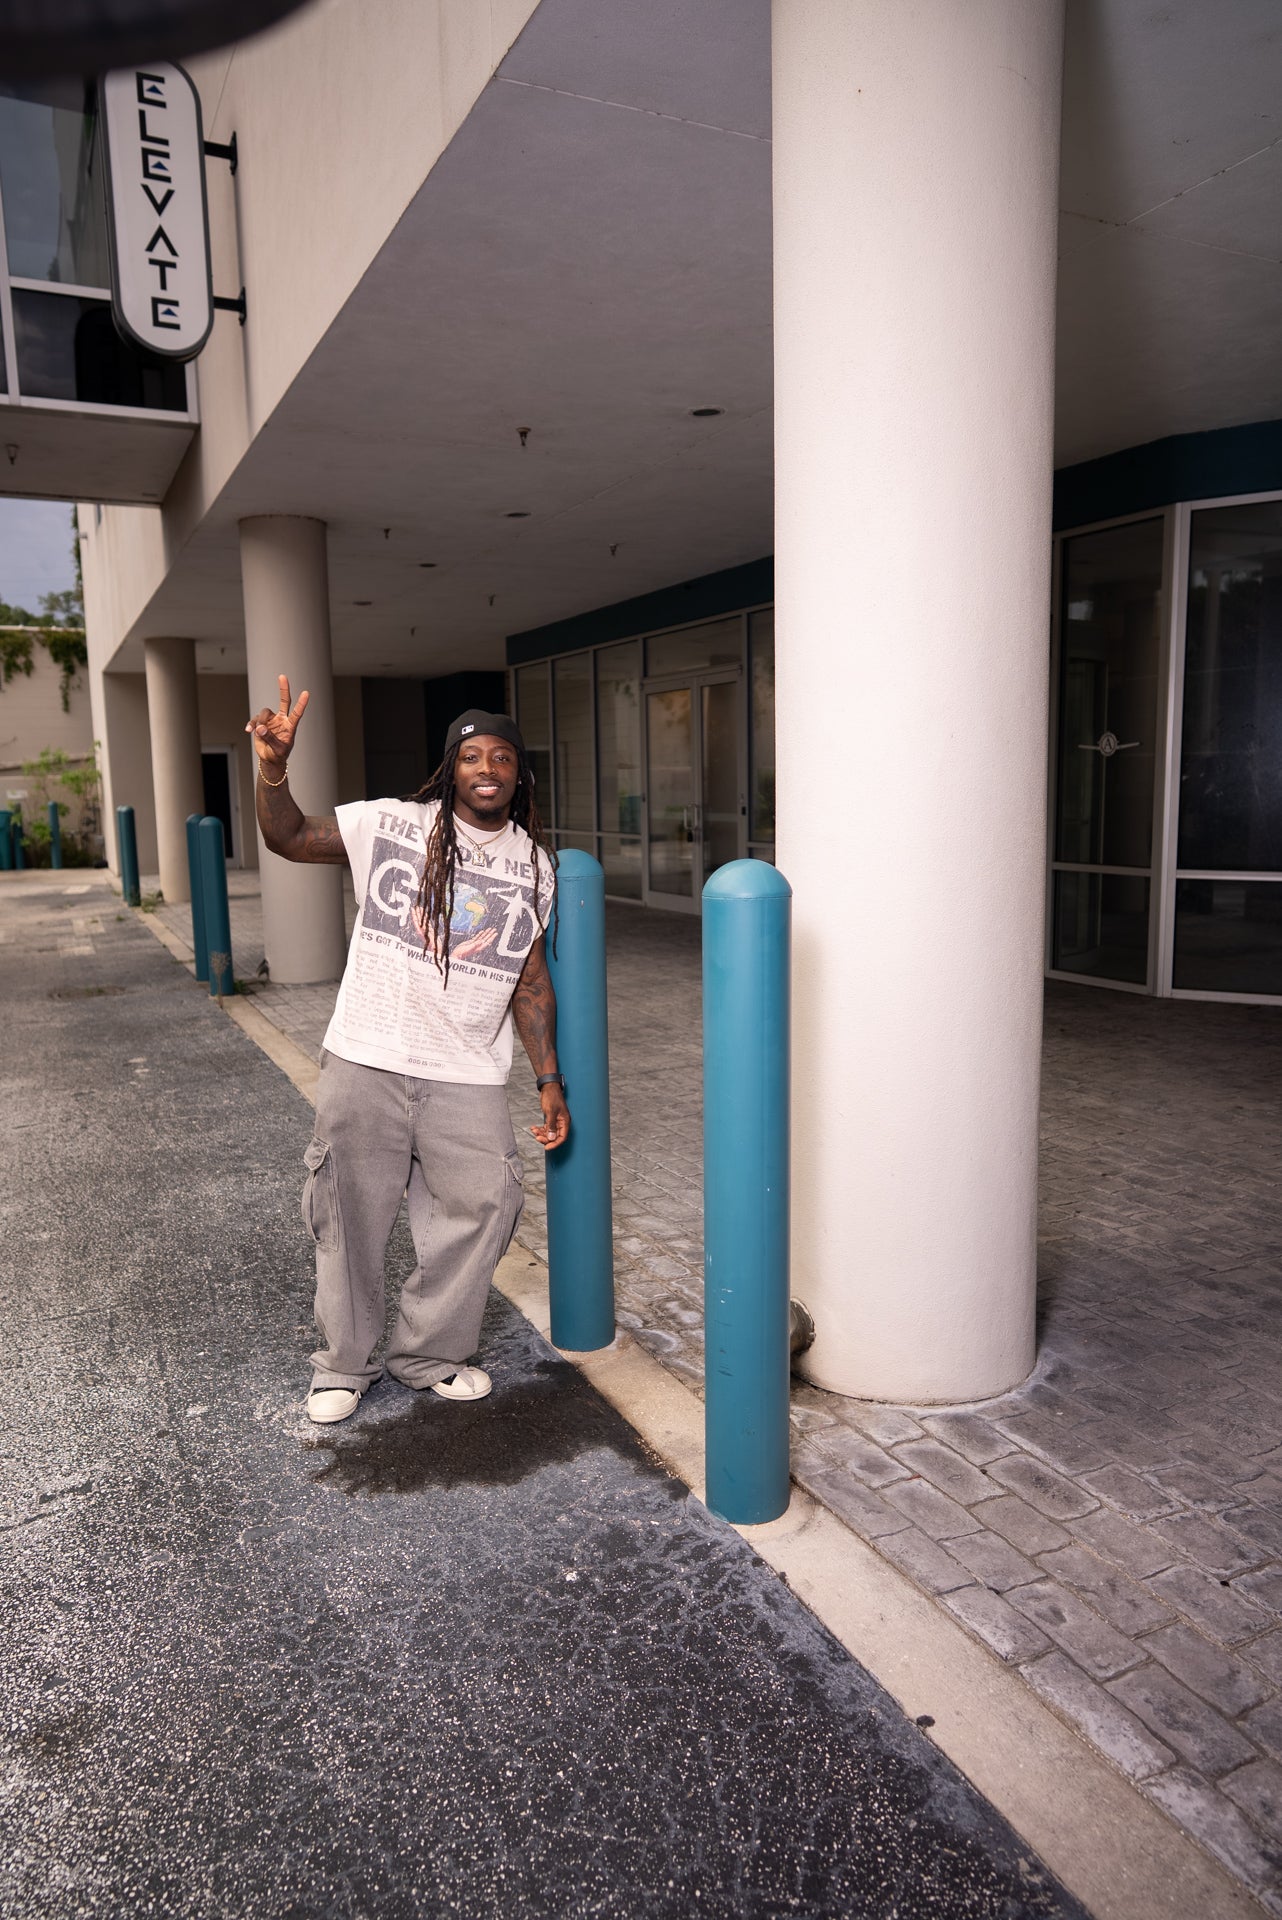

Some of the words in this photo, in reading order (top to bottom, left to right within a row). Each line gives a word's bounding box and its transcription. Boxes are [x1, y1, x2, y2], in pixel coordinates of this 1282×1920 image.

[135, 71, 181, 331] ELEVATE
[378, 810, 422, 843] THE
[376, 935, 391, 947] GOT
[478, 969, 488, 978] IN
[489, 971, 504, 982] HIS
